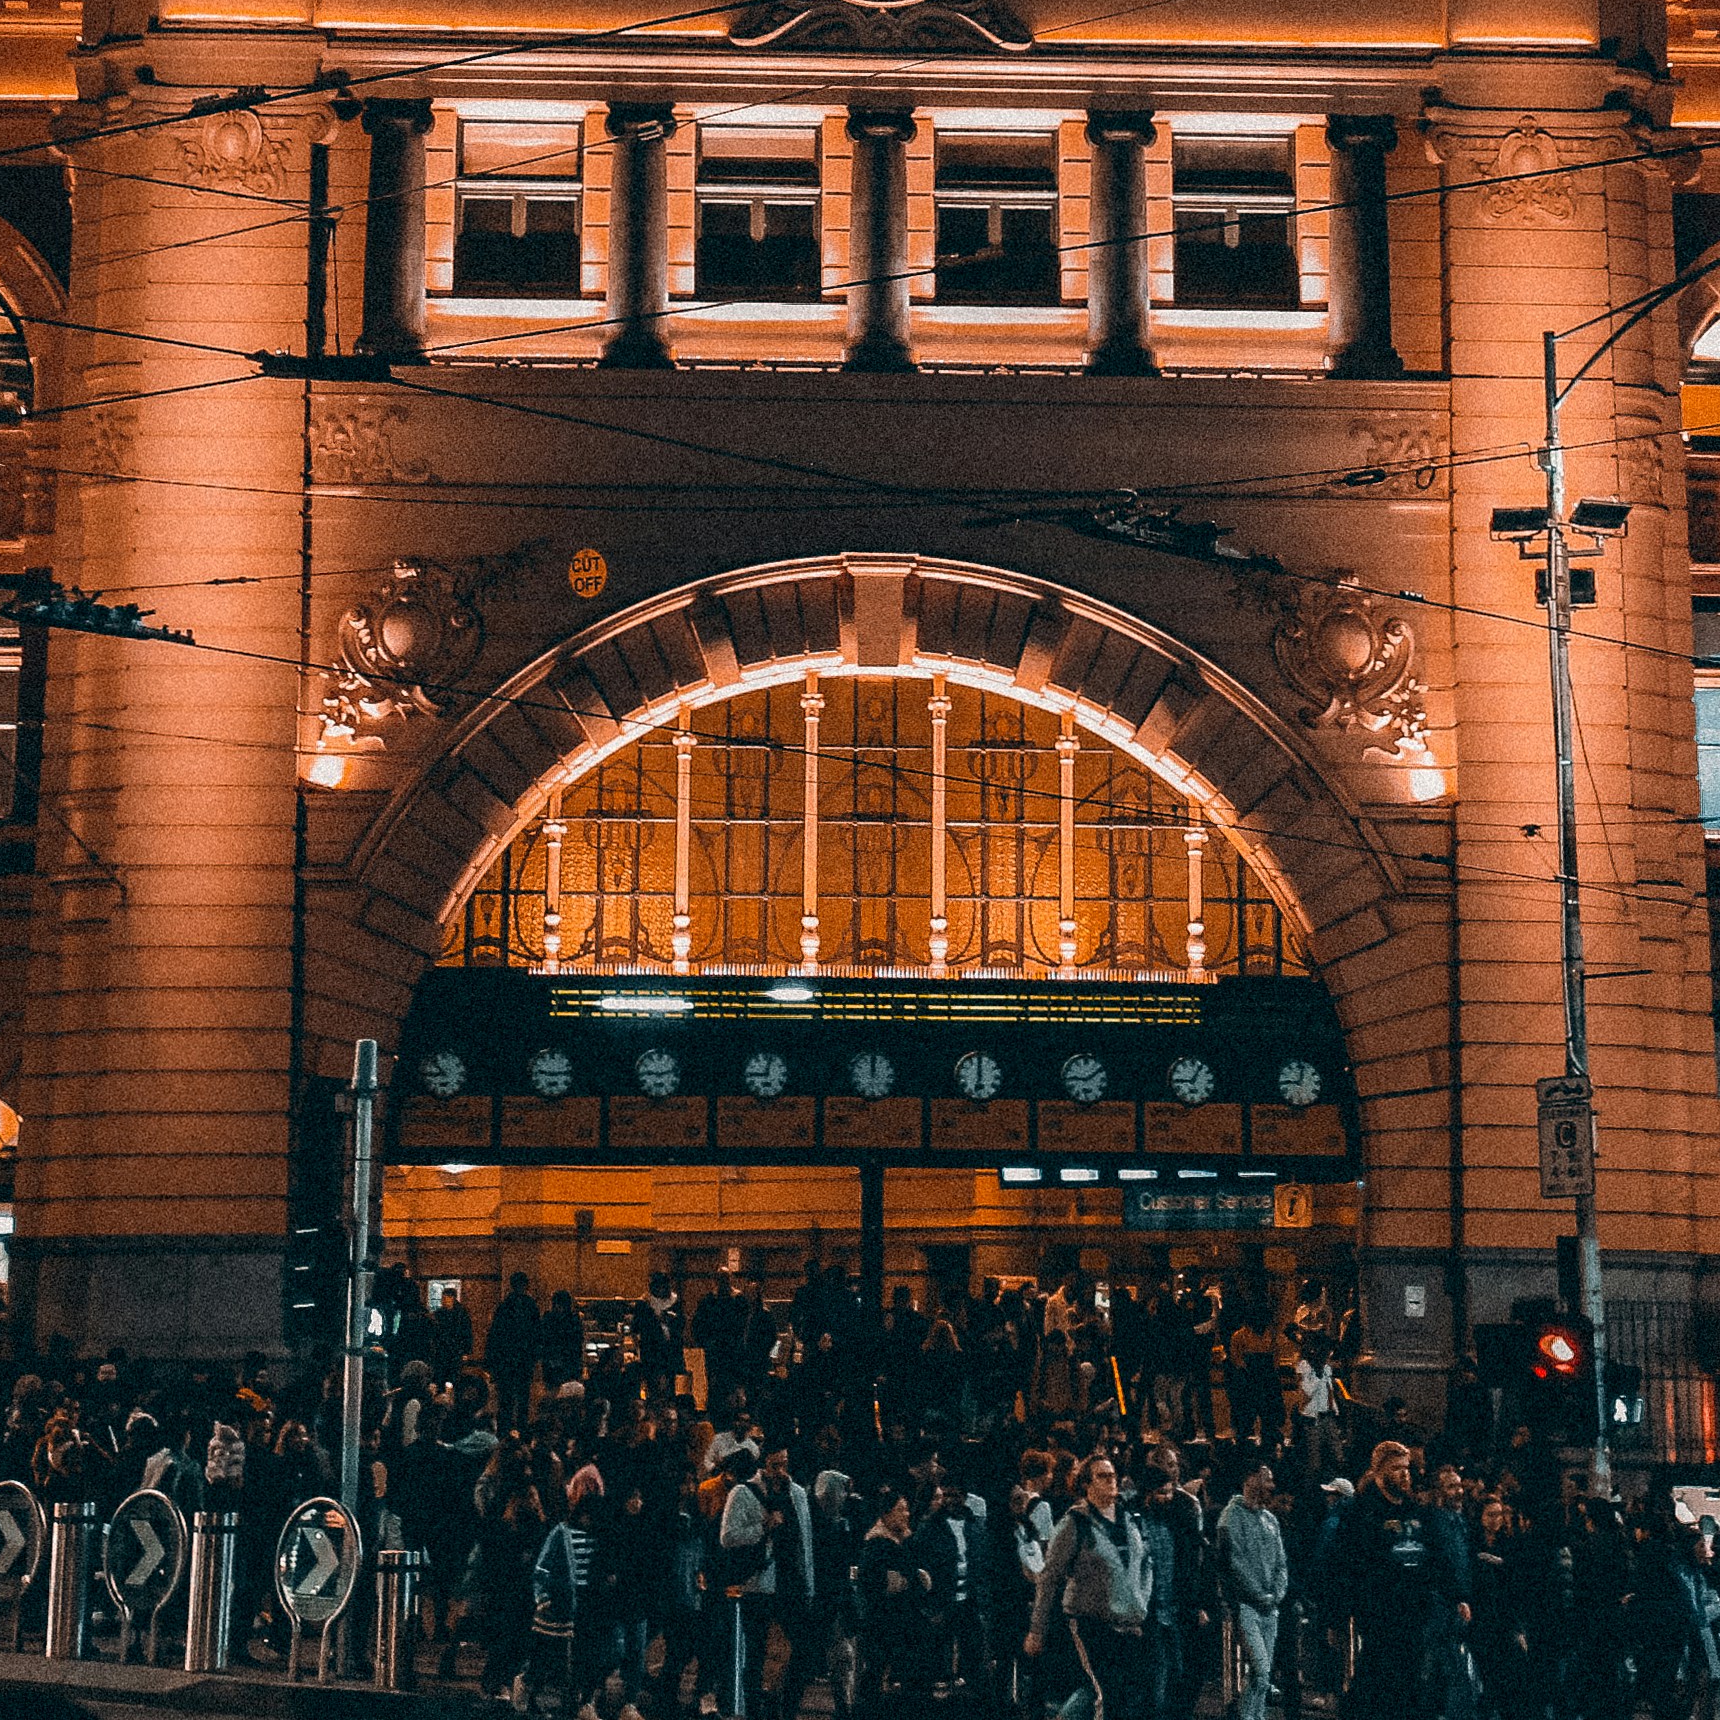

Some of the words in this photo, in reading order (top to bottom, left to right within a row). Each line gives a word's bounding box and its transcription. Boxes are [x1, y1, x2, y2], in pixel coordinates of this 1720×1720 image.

[572, 556, 600, 572] CUT
[574, 576, 603, 592] OFF
[1138, 1191, 1212, 1211] Customer
[1216, 1191, 1273, 1211] Service
